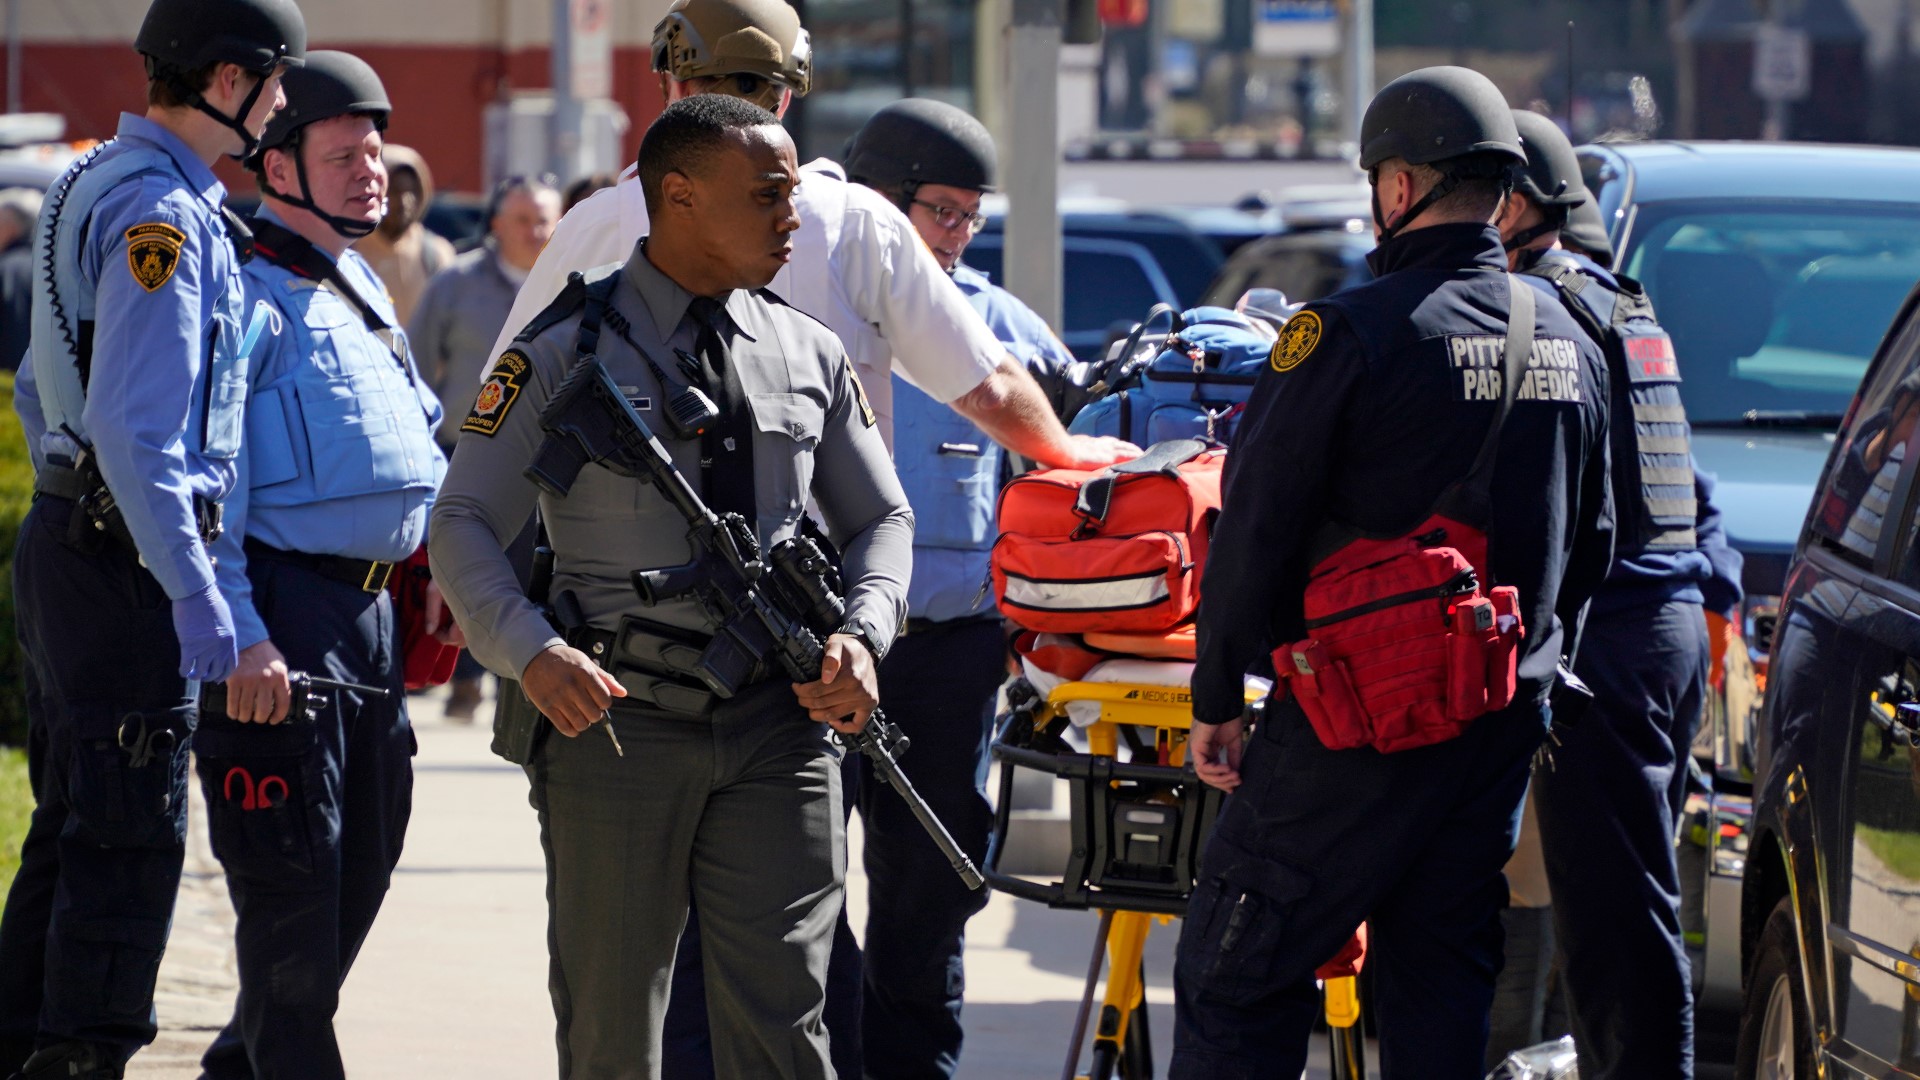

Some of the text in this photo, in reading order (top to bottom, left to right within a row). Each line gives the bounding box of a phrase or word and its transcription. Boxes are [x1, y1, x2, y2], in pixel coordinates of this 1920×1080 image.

[1451, 337, 1579, 370] PITTURGH
[1463, 369, 1580, 401] PARMEDIC
[1477, 609, 1490, 623] TQ
[1142, 690, 1169, 702] MEDIC
